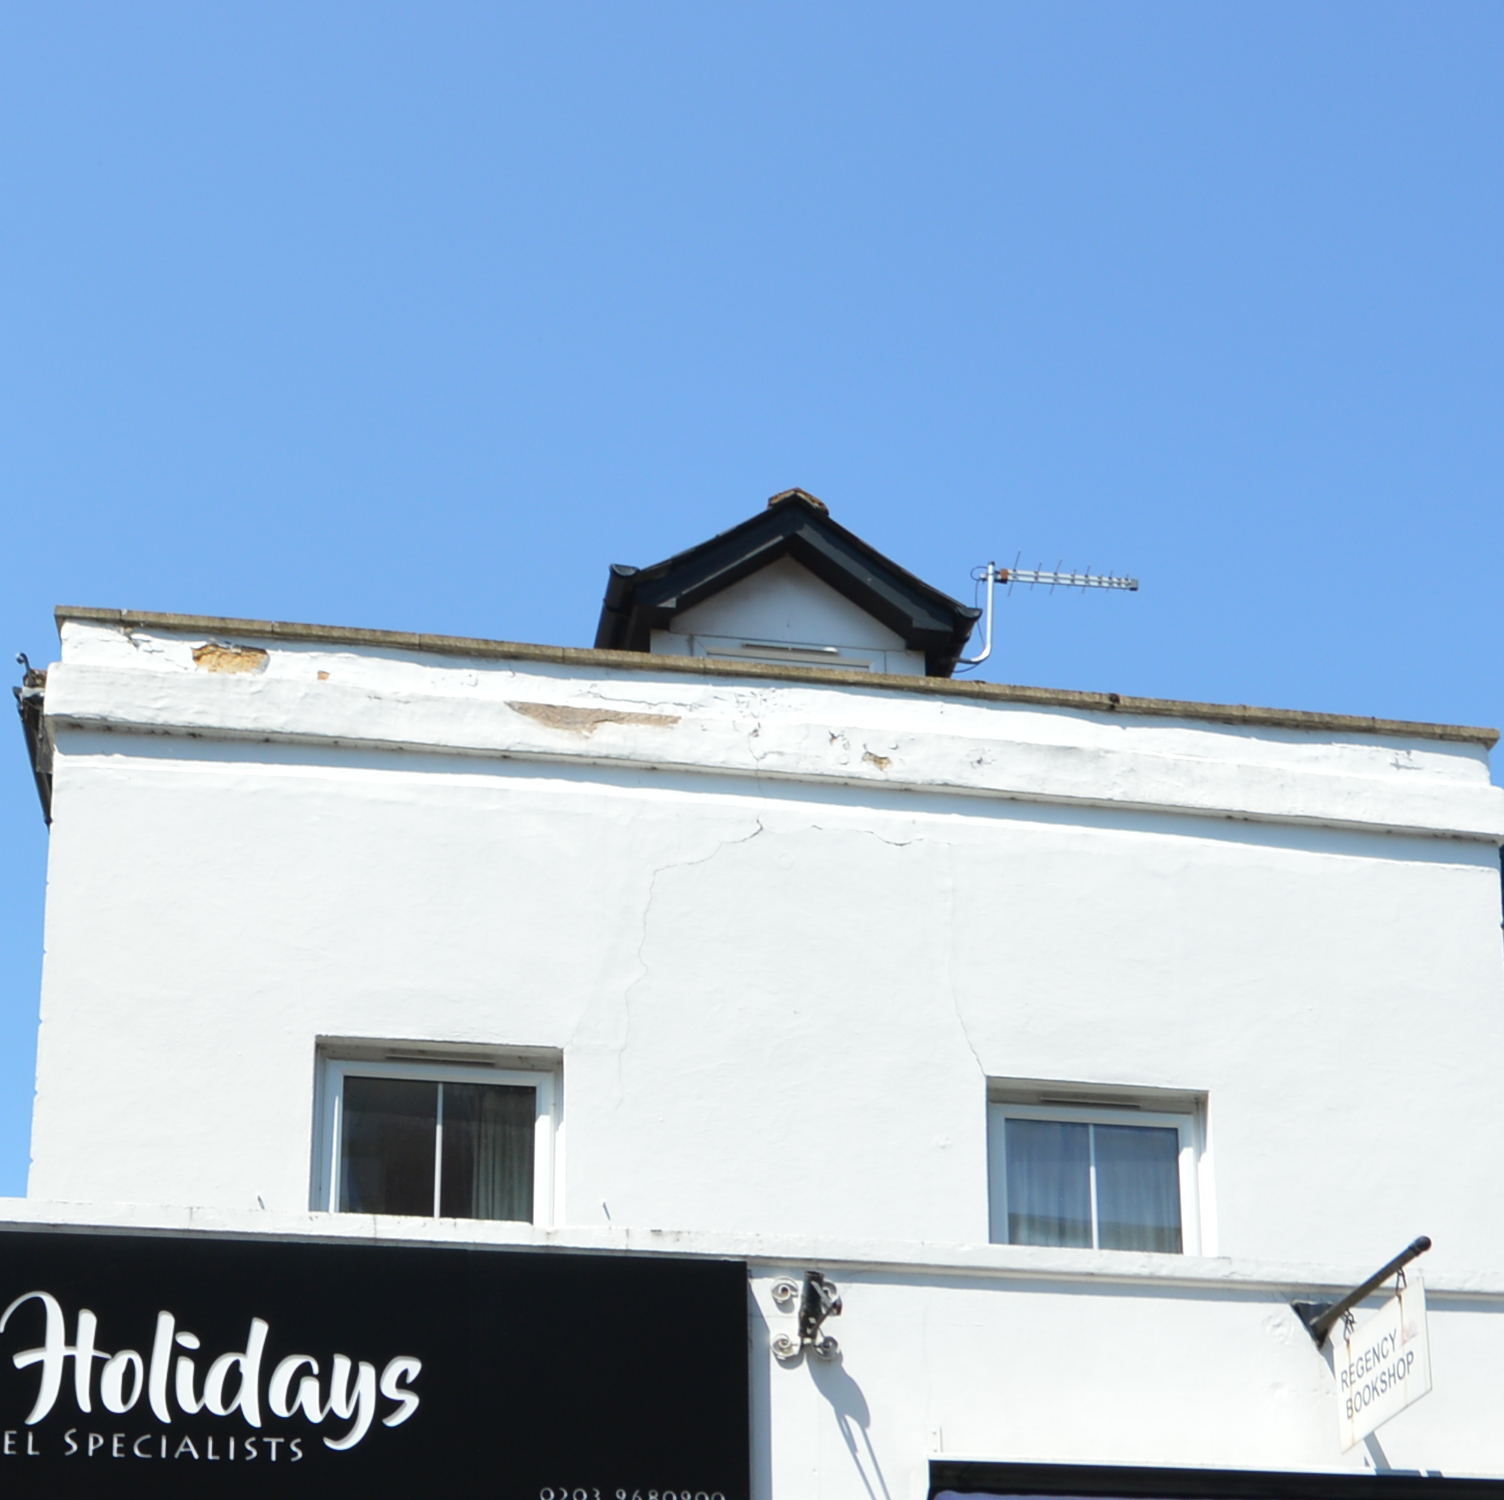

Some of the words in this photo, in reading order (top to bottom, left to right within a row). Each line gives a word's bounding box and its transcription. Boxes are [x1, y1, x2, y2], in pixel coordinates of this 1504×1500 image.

[1341, 1329, 1398, 1393] REGENCY
[1346, 1350, 1415, 1421] BOOKSHOP
[64, 1428, 303, 1463] SPECIALISTS
